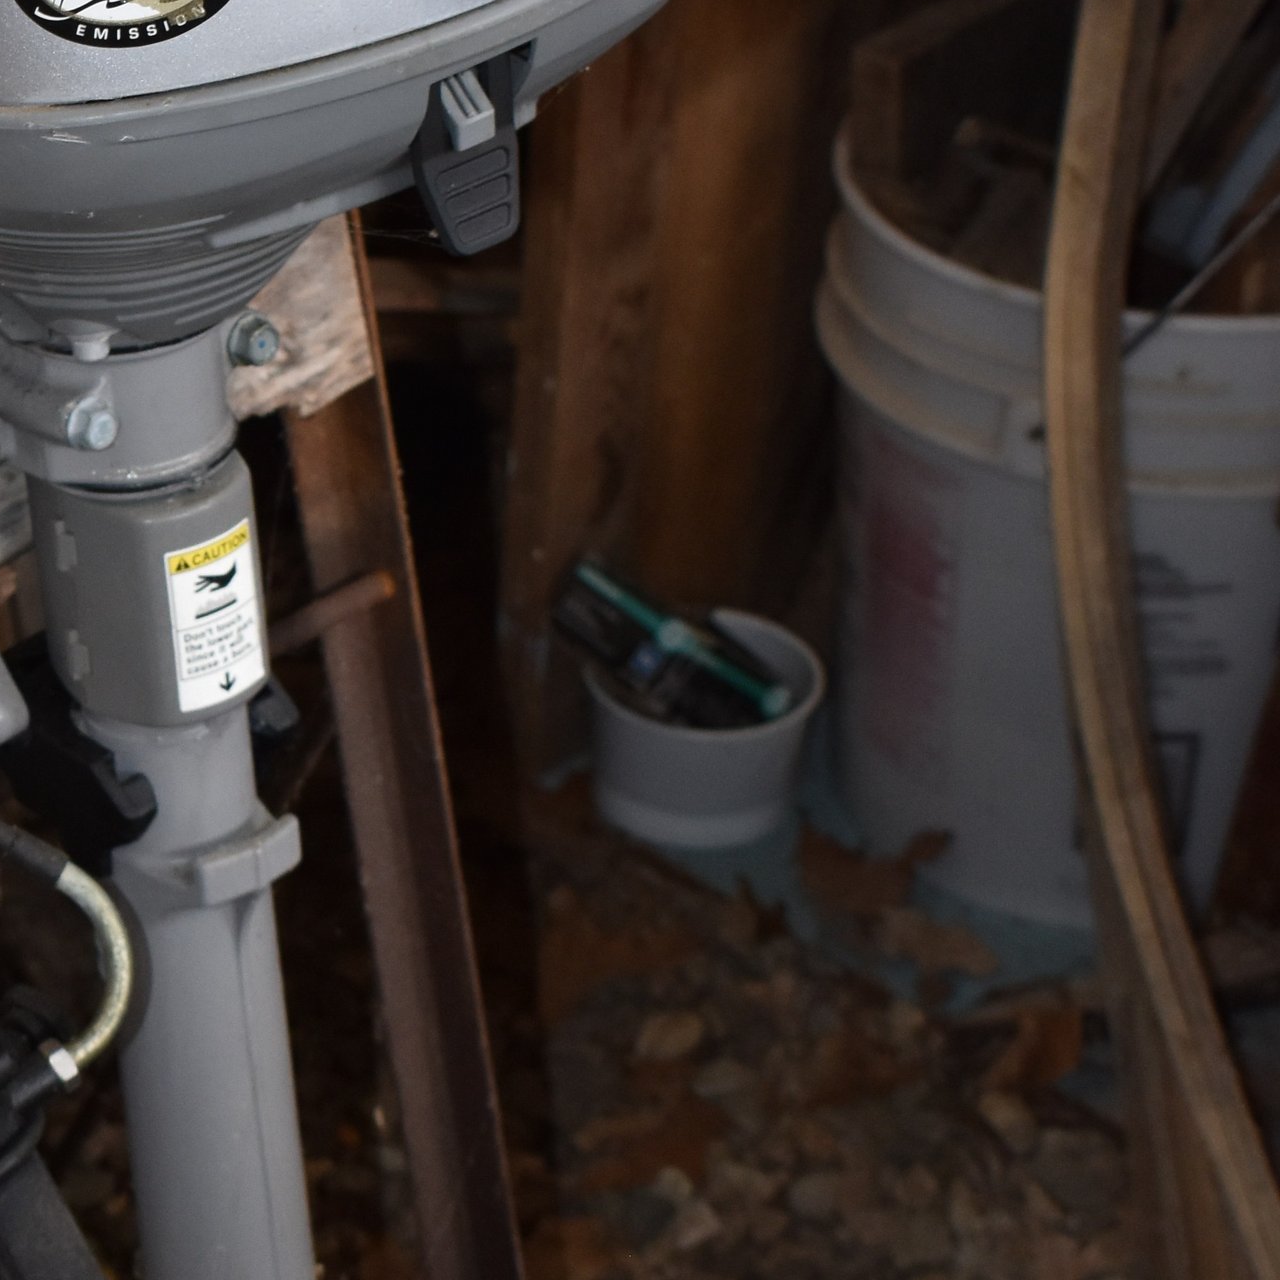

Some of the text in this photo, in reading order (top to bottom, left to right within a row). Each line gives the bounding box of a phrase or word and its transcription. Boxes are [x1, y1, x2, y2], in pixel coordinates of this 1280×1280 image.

[76, 5, 207, 41] EMISSION
[191, 531, 248, 567] CAUTION
[183, 614, 242, 644] Don't touch
[185, 641, 203, 654] the
[207, 631, 234, 647] lower
[186, 650, 215, 664] since
[187, 660, 219, 675] cause
